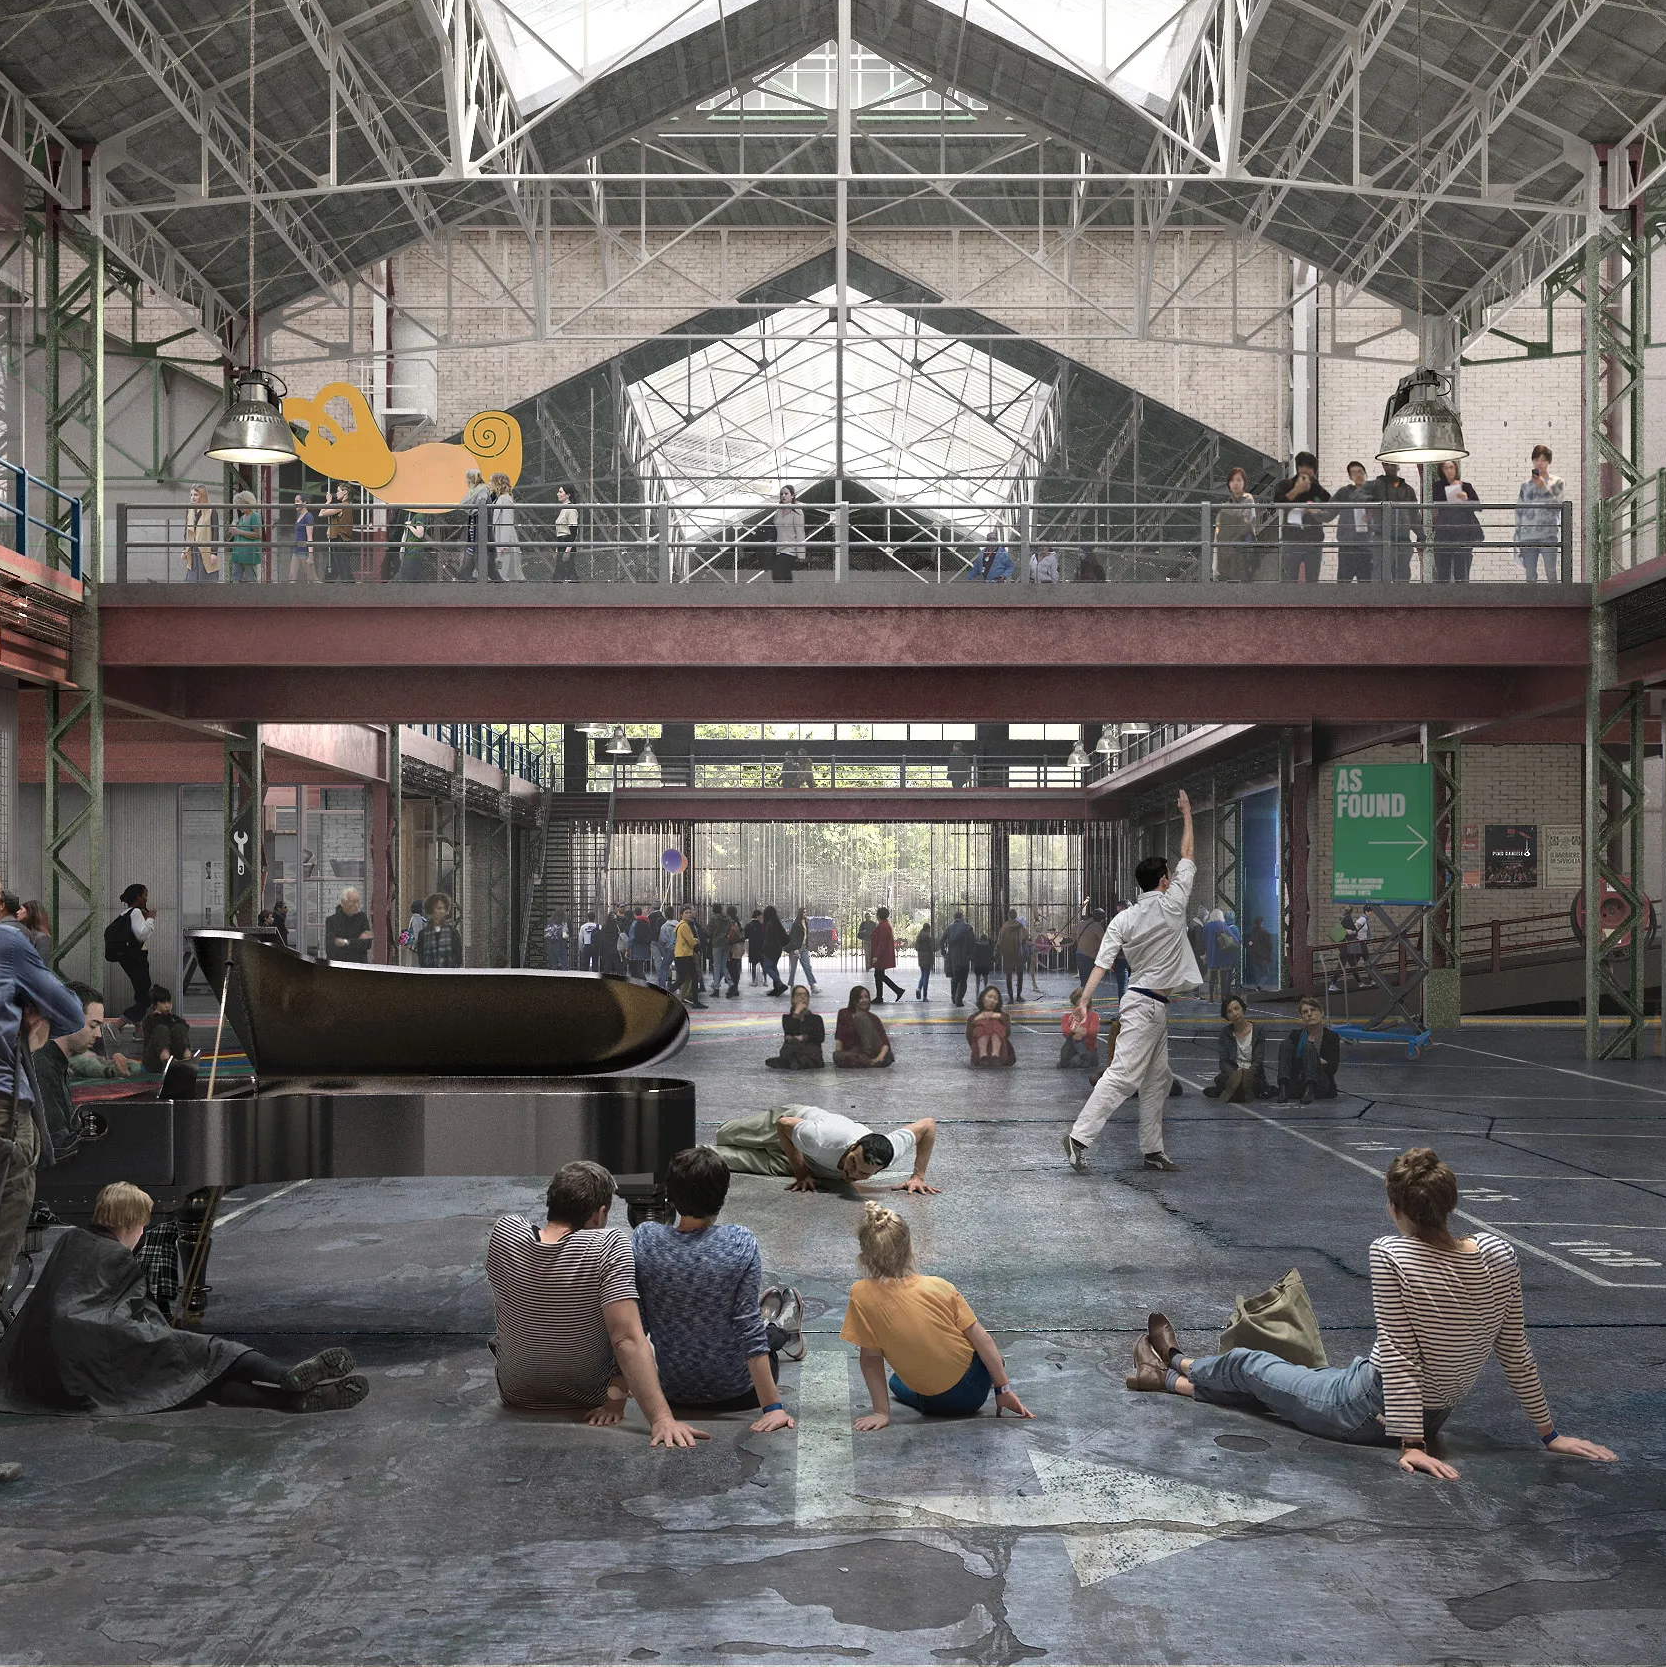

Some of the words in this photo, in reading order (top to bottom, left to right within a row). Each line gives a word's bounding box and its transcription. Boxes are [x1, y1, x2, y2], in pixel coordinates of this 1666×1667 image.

[1336, 768, 1363, 793] AS
[1337, 793, 1406, 818] FOUND
[238, 865, 244, 874] 3
